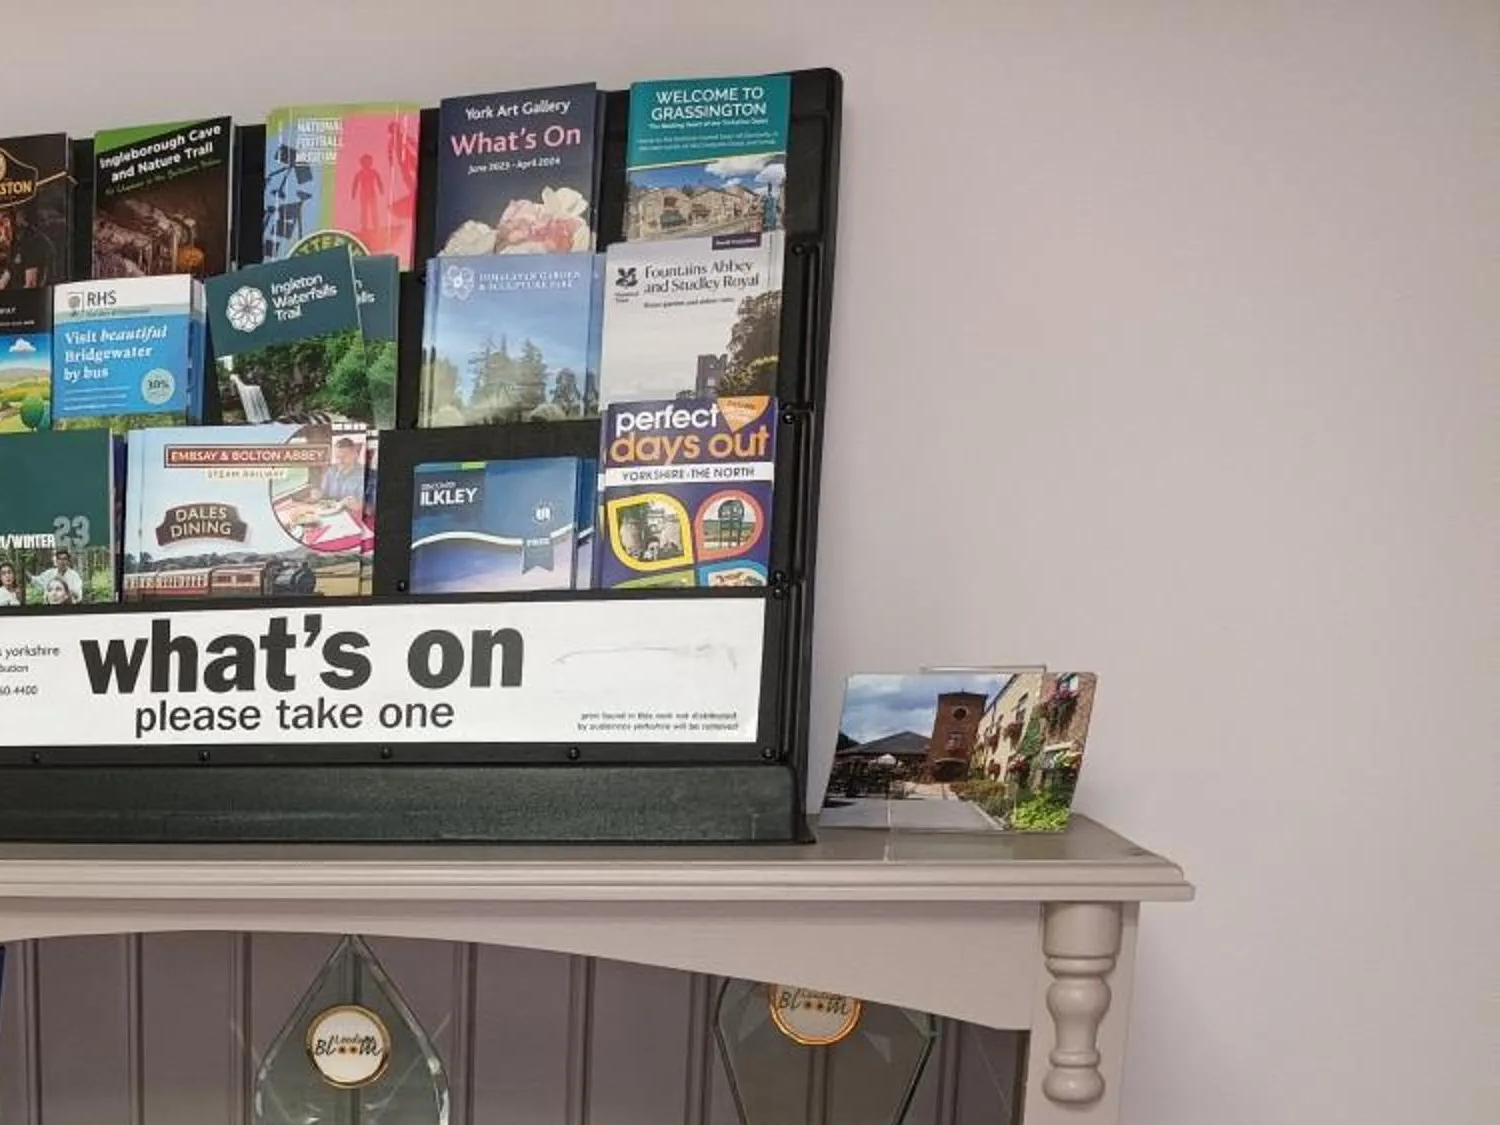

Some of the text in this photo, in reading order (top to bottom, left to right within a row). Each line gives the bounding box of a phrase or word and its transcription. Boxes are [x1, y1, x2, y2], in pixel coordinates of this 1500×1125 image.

[656, 87, 764, 104] WELCOME TO
[465, 100, 571, 120] York Art Gallery
[652, 103, 767, 121] GRASSINGTON
[100, 125, 221, 169] Ingleborough Cave
[451, 125, 581, 157] What's On
[112, 165, 135, 183] and
[138, 154, 181, 174] Nature
[184, 142, 213, 159] Trail
[468, 164, 487, 175] June
[517, 159, 537, 169] April
[645, 259, 754, 279] Fountains Abbey
[271, 274, 323, 295] Ingleton
[644, 273, 760, 293] and Studley Royal
[87, 290, 117, 306] RHS
[272, 284, 338, 309] Waterfalls
[275, 305, 302, 321] Trail
[65, 324, 168, 344] Visit beautiful
[65, 347, 153, 363] Bridgewater
[64, 366, 109, 383] by bus
[616, 404, 720, 437] perfect
[610, 425, 771, 466] days out
[171, 450, 325, 462] EMBSAY & BOLTON ABBEY
[622, 469, 684, 482] YORKSHIRE
[714, 467, 756, 479] NORTH
[420, 488, 479, 507] ILKLEY
[175, 507, 228, 523] DALES
[53, 515, 91, 550] 23
[170, 521, 233, 539] DINING
[5, 645, 61, 661] yorkshire
[79, 613, 524, 695] what's on
[134, 697, 455, 739] please take one
